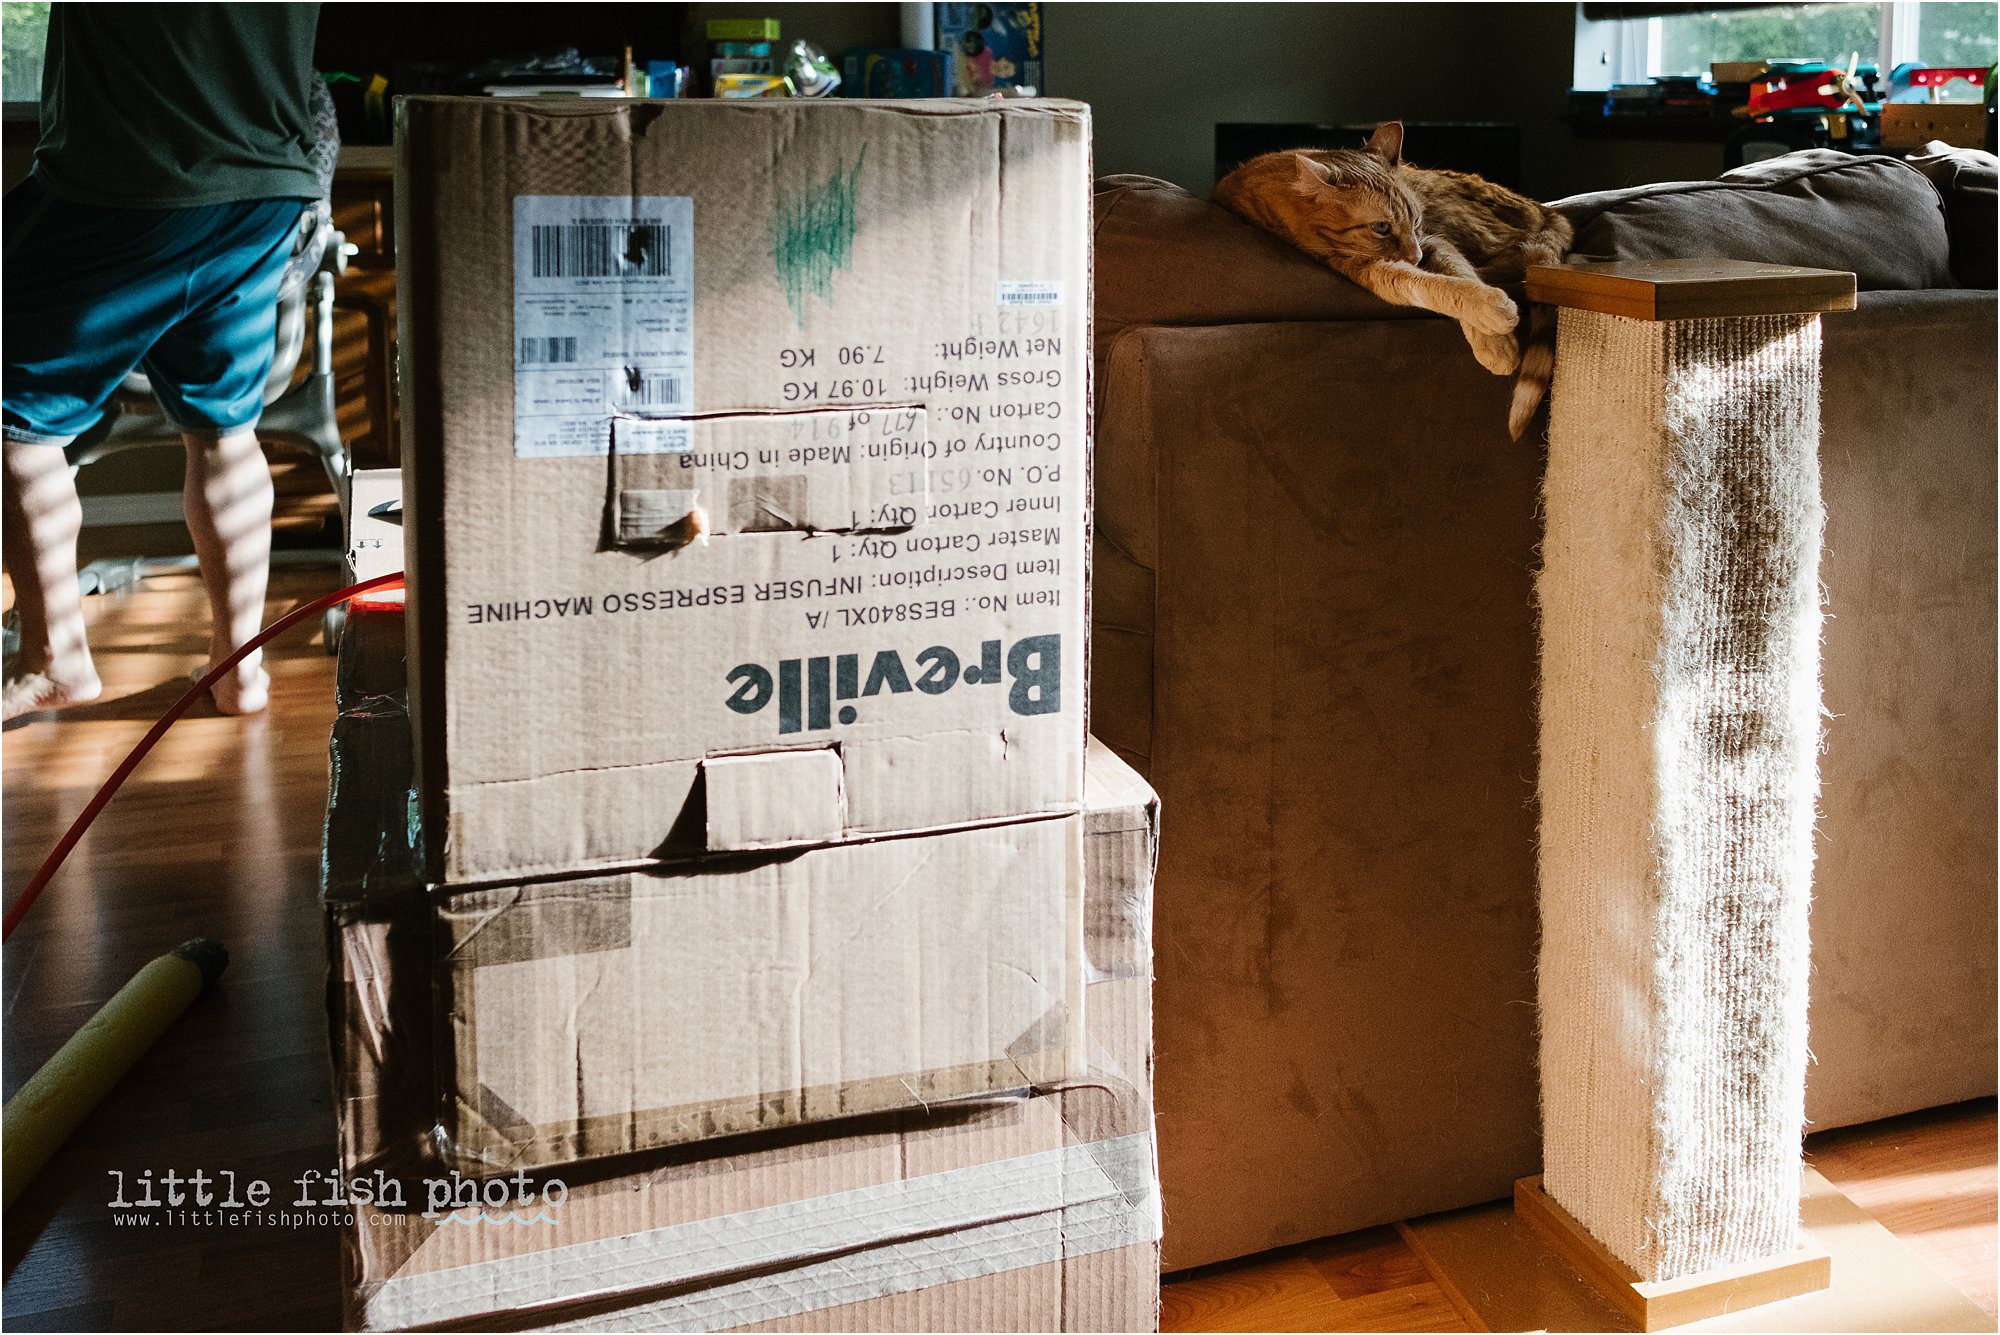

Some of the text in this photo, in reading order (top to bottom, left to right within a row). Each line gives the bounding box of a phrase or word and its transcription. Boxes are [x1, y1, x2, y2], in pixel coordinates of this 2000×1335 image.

[780, 337, 1061, 368] Net Weight: 7.90 KG
[782, 370, 1061, 401] Gross Weight: 10.97 KG
[848, 411, 870, 430] of
[938, 406, 980, 424] No.:
[990, 402, 1061, 419] Carton
[679, 433, 1061, 472] Country of Origin: Made in China
[978, 467, 1012, 486] No.
[1021, 464, 1061, 484] P.O.
[870, 505, 916, 527] Qty:
[1006, 496, 1060, 515] Inner
[850, 510, 860, 529] 1
[832, 527, 1060, 563] Master Carton Qty: 1
[467, 558, 1060, 624] Item Description: INFUSER ESPRESSO MACHINE
[806, 590, 1060, 630] Item No.: BES840XL /A
[724, 634, 1061, 735] Breville
